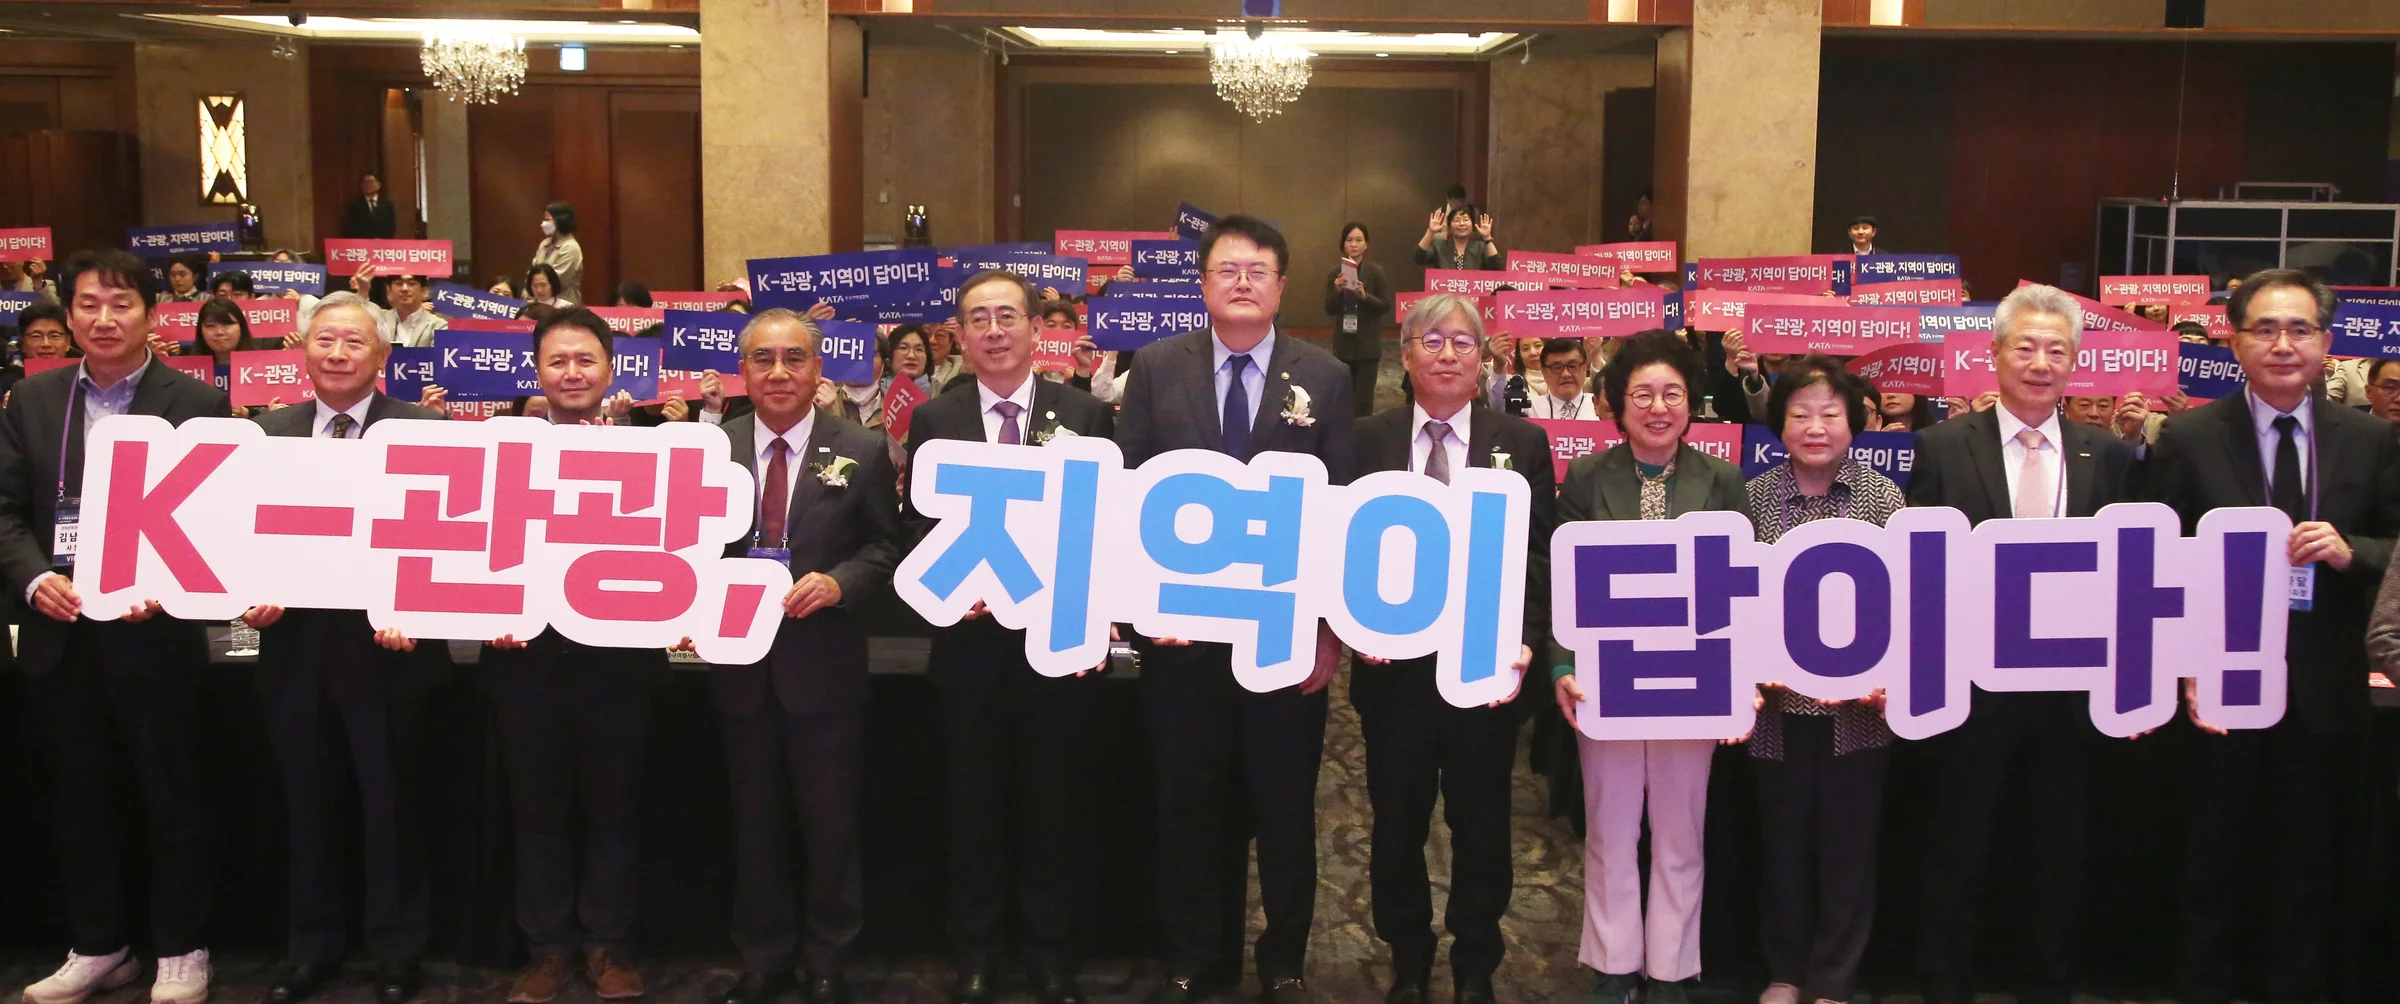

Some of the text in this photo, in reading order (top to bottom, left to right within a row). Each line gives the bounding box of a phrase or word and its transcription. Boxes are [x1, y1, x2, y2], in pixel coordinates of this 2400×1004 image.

[9, 236, 46, 250] 답이다!
[170, 232, 200, 245] 지역이
[1060, 239, 1098, 253] K-관광,
[1099, 240, 1129, 252] 지역이
[372, 248, 407, 262] 지역이
[408, 249, 447, 263] 답이다!
[1138, 250, 1182, 266] K-관광,
[1617, 250, 1643, 262] 지역이
[1644, 249, 1672, 261] 답이다!
[1041, 264, 1081, 281] 답이다!
[1550, 262, 1580, 275] 지역이
[1581, 263, 1615, 278] 답이다!
[1703, 265, 1827, 283] K-관광, 지역이 답이다!
[1861, 262, 1956, 274] K-관광, 지역이 답이다!
[251, 269, 283, 281] 지역이
[284, 270, 321, 285] 답이다!
[758, 262, 930, 293] K-관광, 지역이 답이다!
[1431, 278, 1471, 294] K-관광,
[2104, 282, 2205, 295] K-관광, 지역이 답이다!
[1885, 290, 1917, 304] 지역이
[1919, 289, 1956, 303] 답이다!
[476, 298, 508, 318] 지역이
[879, 311, 901, 319] KATA
[1504, 301, 1655, 322] K-관광, 지역이 답이다!
[249, 309, 291, 325] 답이다!
[1096, 311, 1158, 333] K-관광,
[1161, 311, 1209, 332] 지역이
[1559, 325, 1581, 333] KATA
[1751, 318, 1911, 339] K-관광, 지역이 답이다!
[672, 327, 739, 354] K-관광,
[1035, 339, 1072, 357] 지역이
[1808, 341, 1831, 349] KATA
[443, 347, 518, 374] K-관광,
[1887, 356, 1936, 377] 지역이
[2101, 348, 2168, 373] 답이다!
[240, 363, 303, 385] K-관광,
[2198, 359, 2247, 383] 답이다!
[1882, 380, 1905, 388] KATA
[100, 440, 768, 638] K-관광,
[918, 459, 1508, 685] 지역이
[1574, 526, 2268, 717] 답이다!
